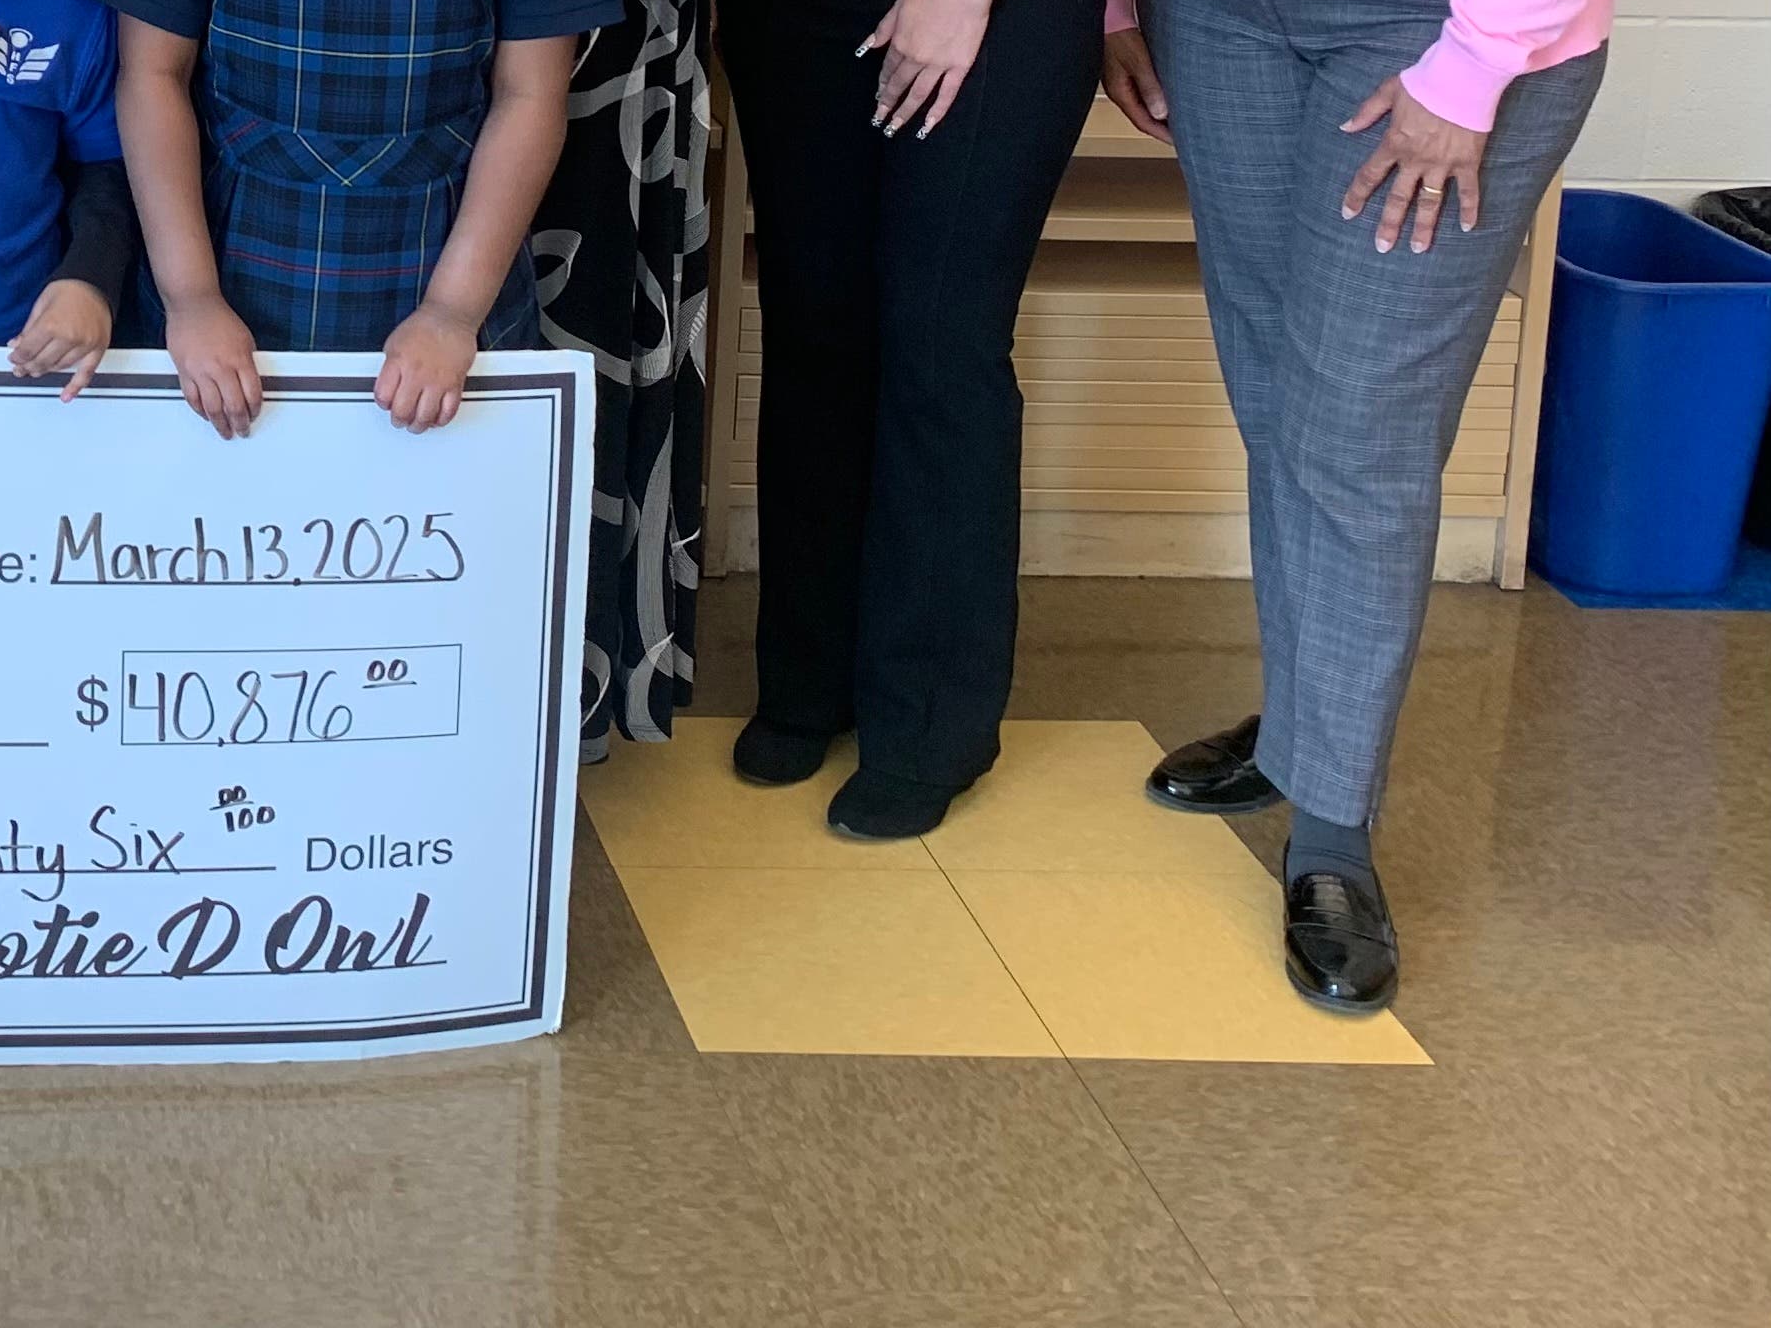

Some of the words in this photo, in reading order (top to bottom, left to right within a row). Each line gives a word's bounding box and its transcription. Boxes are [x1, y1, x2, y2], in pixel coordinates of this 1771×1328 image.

[52, 513, 227, 584] March
[312, 512, 467, 581] 2025
[89, 804, 187, 874] Six
[305, 834, 454, 873] Dollars
[155, 894, 242, 979] D
[263, 892, 435, 975] Owl
